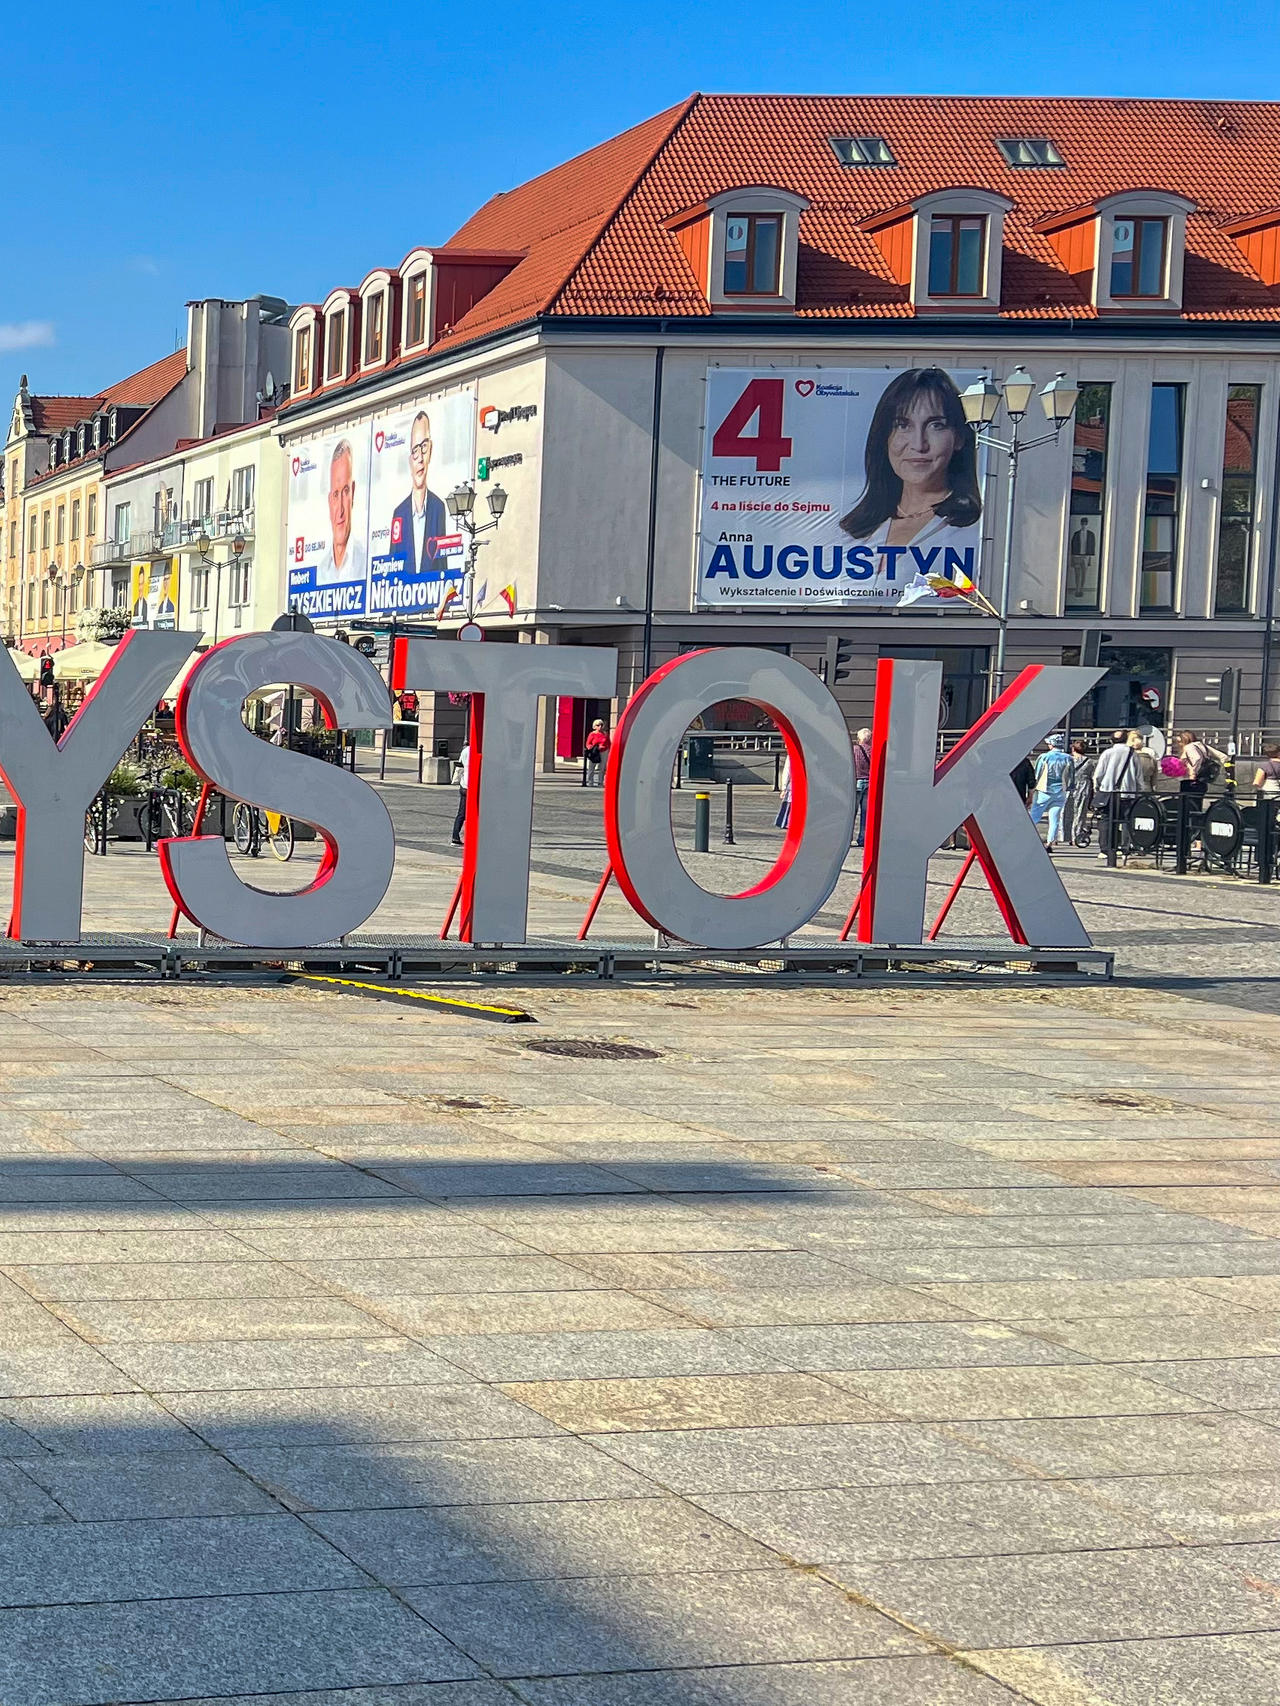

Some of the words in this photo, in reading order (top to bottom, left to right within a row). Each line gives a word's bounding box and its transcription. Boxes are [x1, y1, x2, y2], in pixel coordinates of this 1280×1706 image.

[712, 379, 792, 472] 4
[711, 475, 737, 486] THE
[740, 475, 791, 486] FUTURE
[711, 501, 719, 511] 4
[721, 503, 737, 511] na
[739, 501, 772, 511] liście
[774, 502, 789, 512] do
[792, 501, 830, 513] Sejmu
[719, 531, 753, 542] Anna
[296, 540, 303, 560] 3
[372, 557, 404, 577] Zbigniew
[705, 544, 975, 581] AUGUSTYN
[290, 570, 310, 586] Robert
[290, 585, 363, 615] TYSZKIEWICZ
[370, 571, 463, 610] Nikitorowicz
[719, 586, 797, 597] Wykształcenie
[805, 586, 884, 597] Doświadczenie
